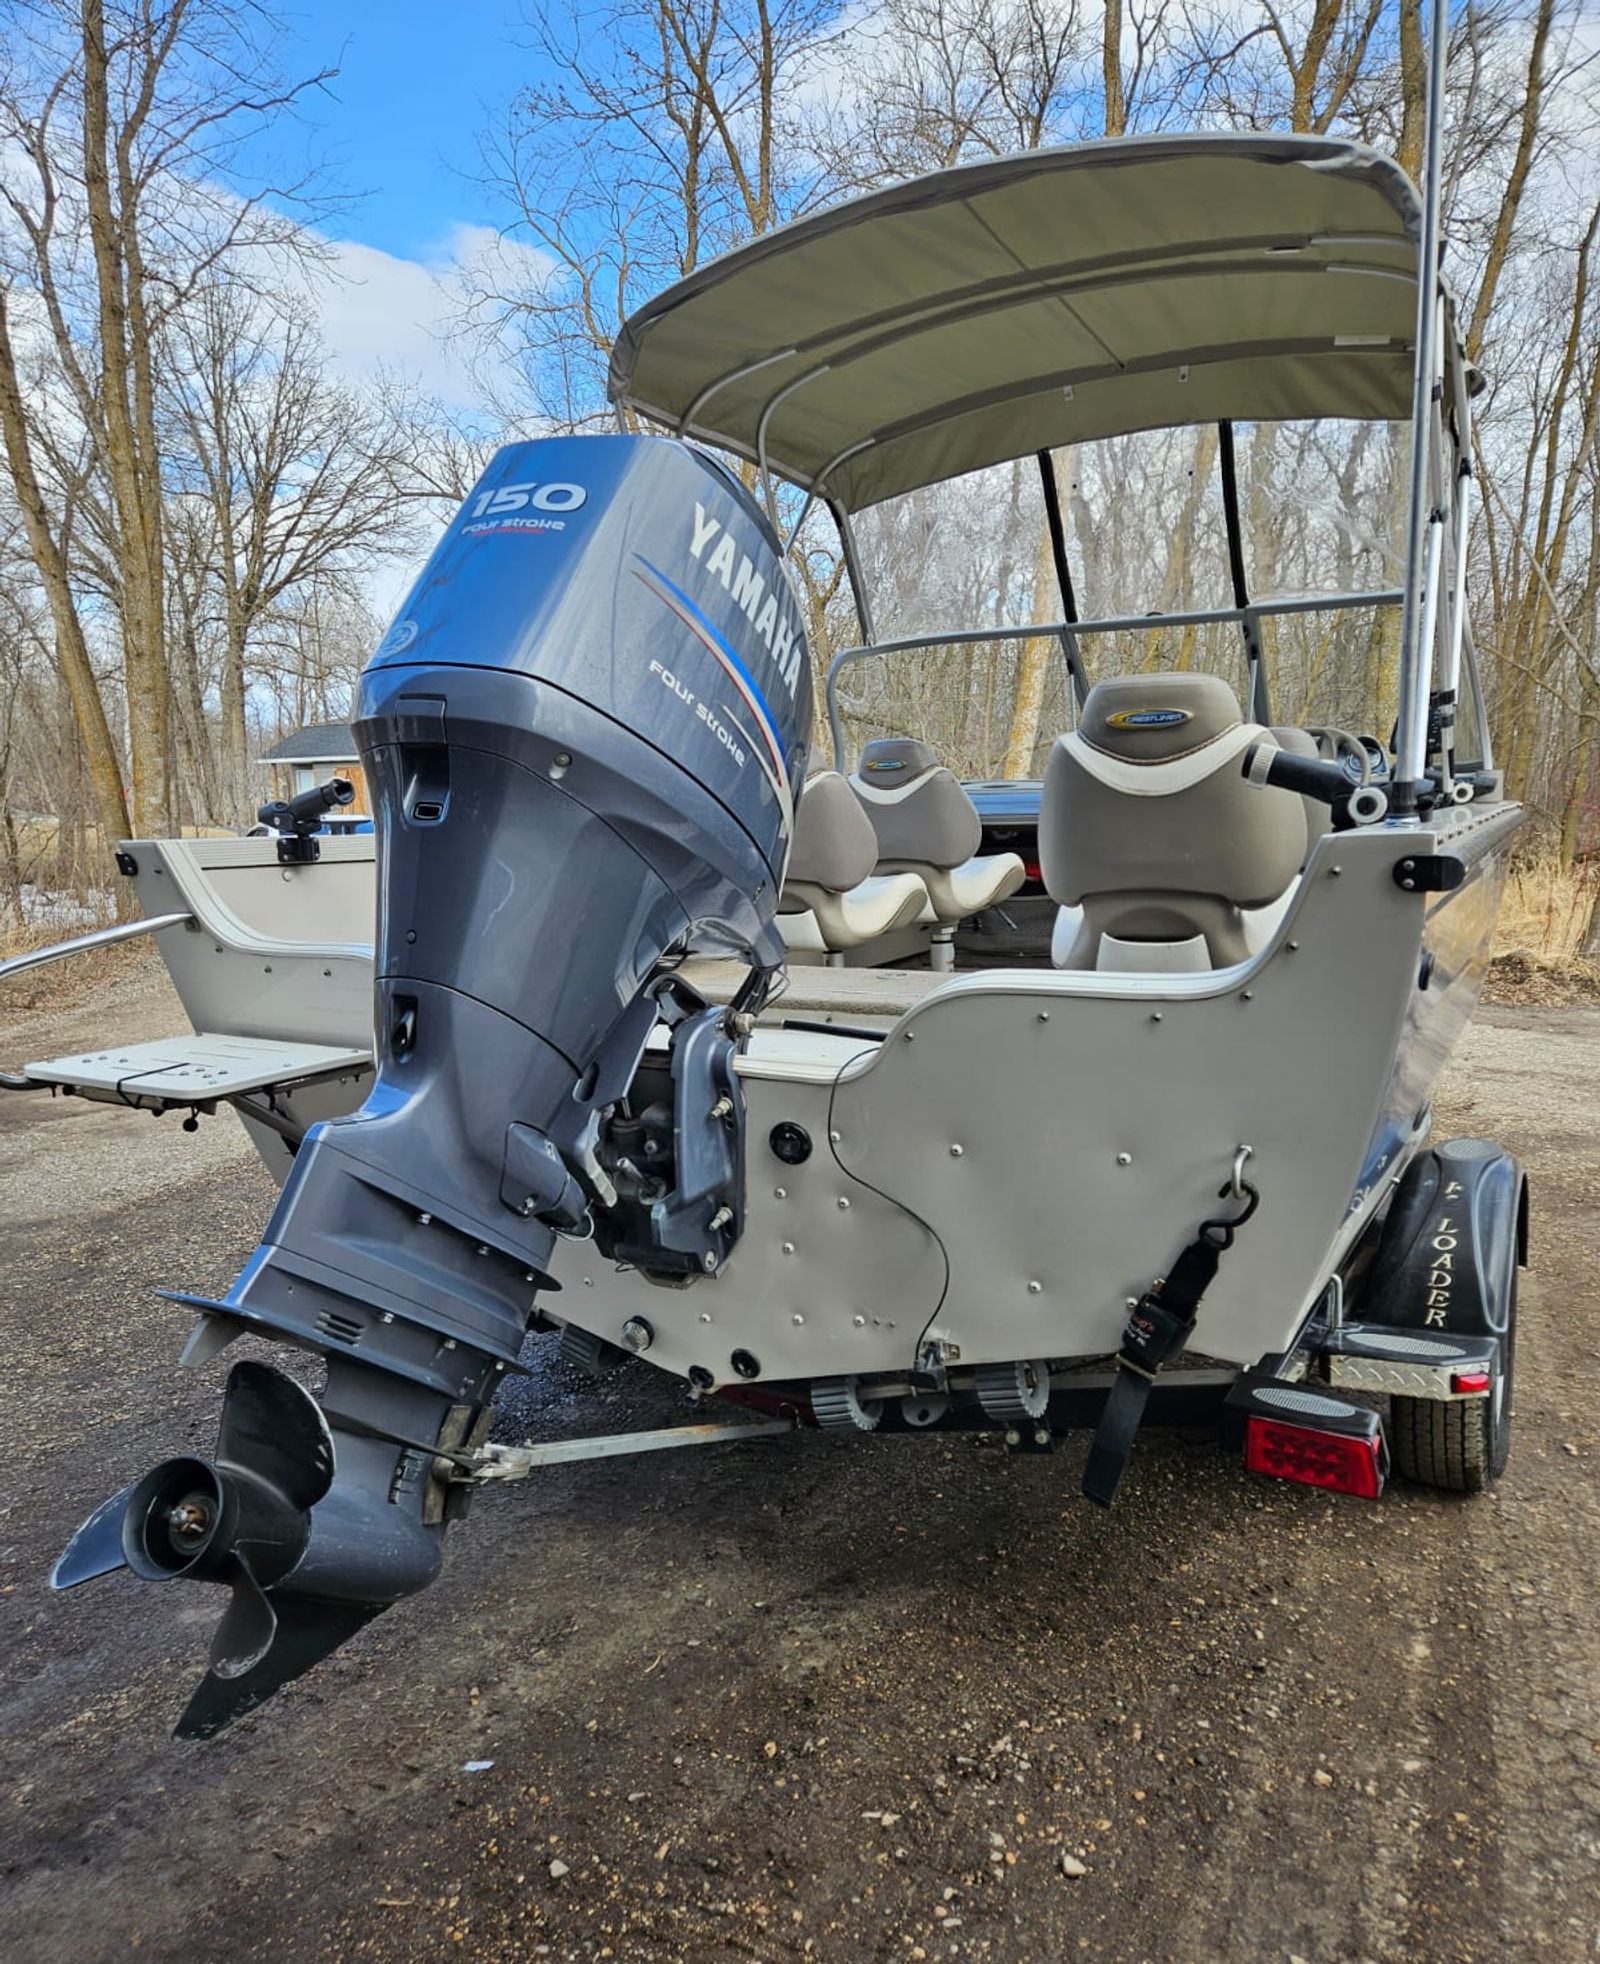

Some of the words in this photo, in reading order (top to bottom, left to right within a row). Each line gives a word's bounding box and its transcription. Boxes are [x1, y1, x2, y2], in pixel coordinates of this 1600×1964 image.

[471, 483, 588, 518] 150
[690, 502, 802, 701] YAMAHA
[1424, 1218, 1459, 1327] LOADER
